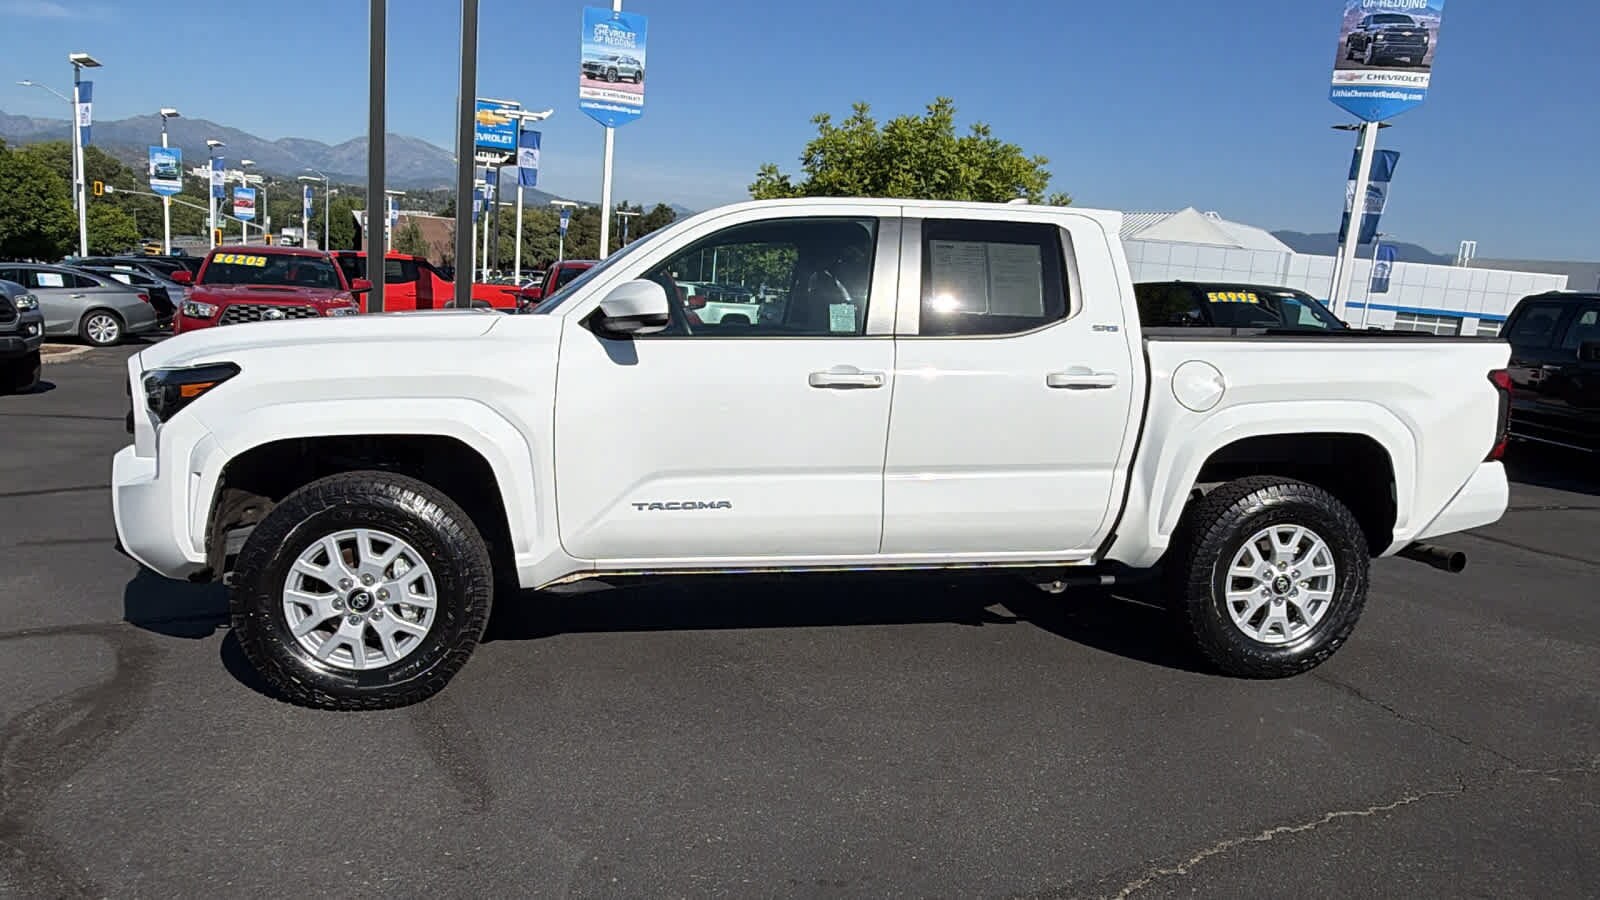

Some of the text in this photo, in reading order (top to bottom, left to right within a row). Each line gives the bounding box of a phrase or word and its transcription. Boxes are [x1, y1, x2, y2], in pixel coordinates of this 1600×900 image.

[1379, 0, 1427, 9] REDDING
[1366, 73, 1424, 83] CHEVROLET
[631, 501, 732, 510] TACOMA
